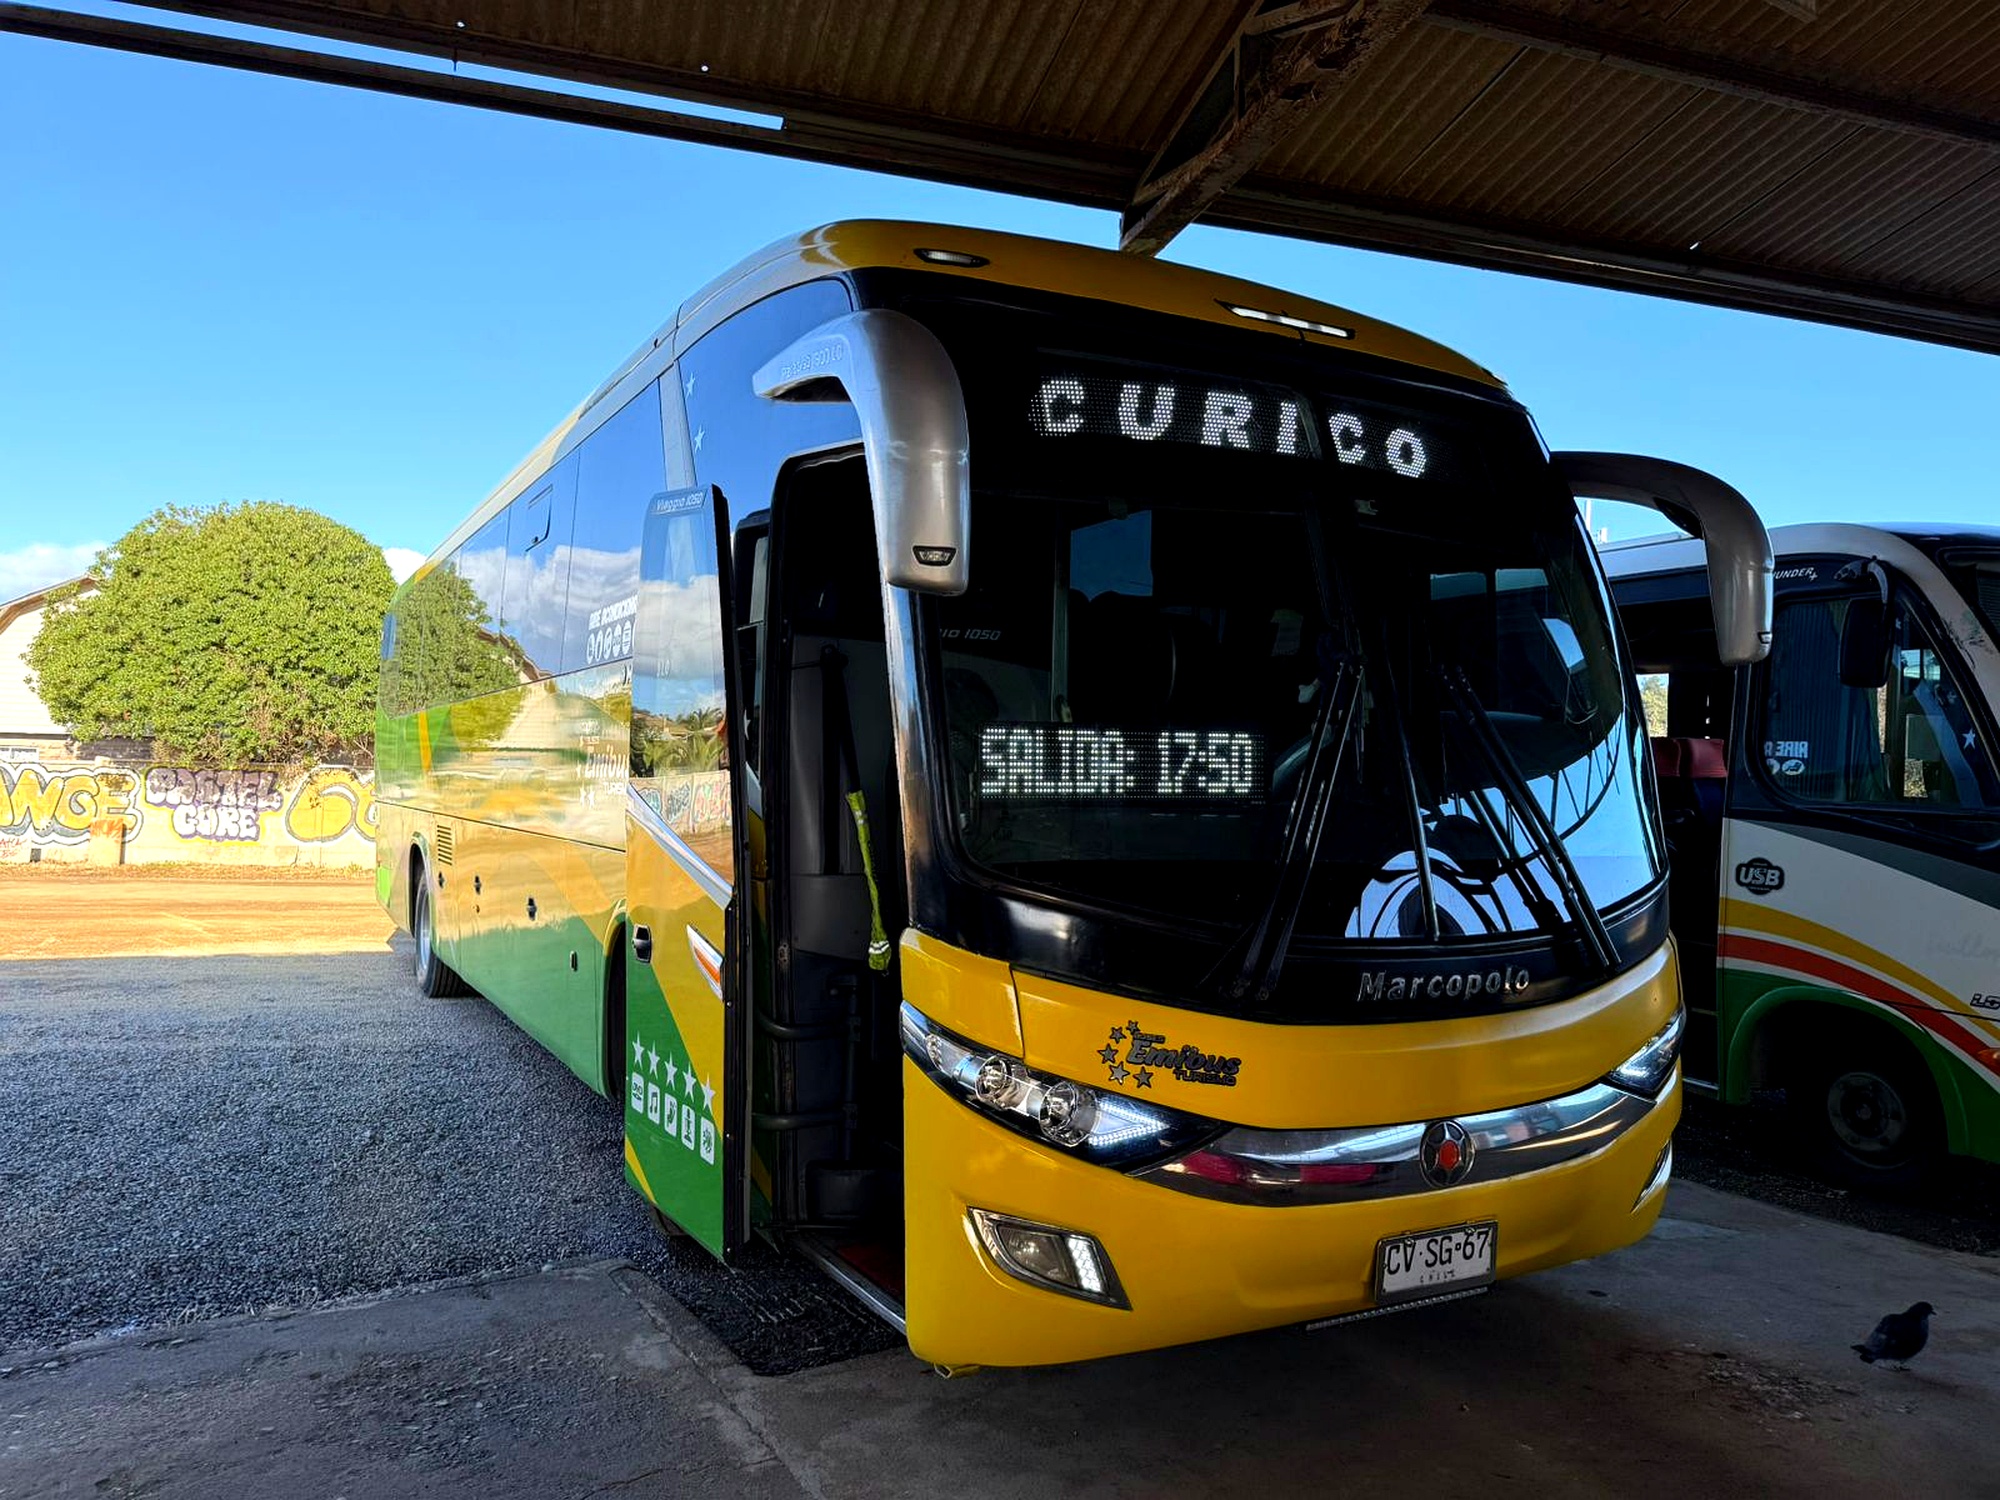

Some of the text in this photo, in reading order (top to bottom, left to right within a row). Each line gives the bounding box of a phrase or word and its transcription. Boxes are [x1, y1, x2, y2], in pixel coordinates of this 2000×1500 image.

[1030, 379, 1427, 478] CURICO
[964, 628, 1002, 641] 1050
[981, 727, 1253, 794] SALIDA: 17:50
[1738, 866, 1781, 886] USB
[1356, 966, 1530, 1002] Marcopolo
